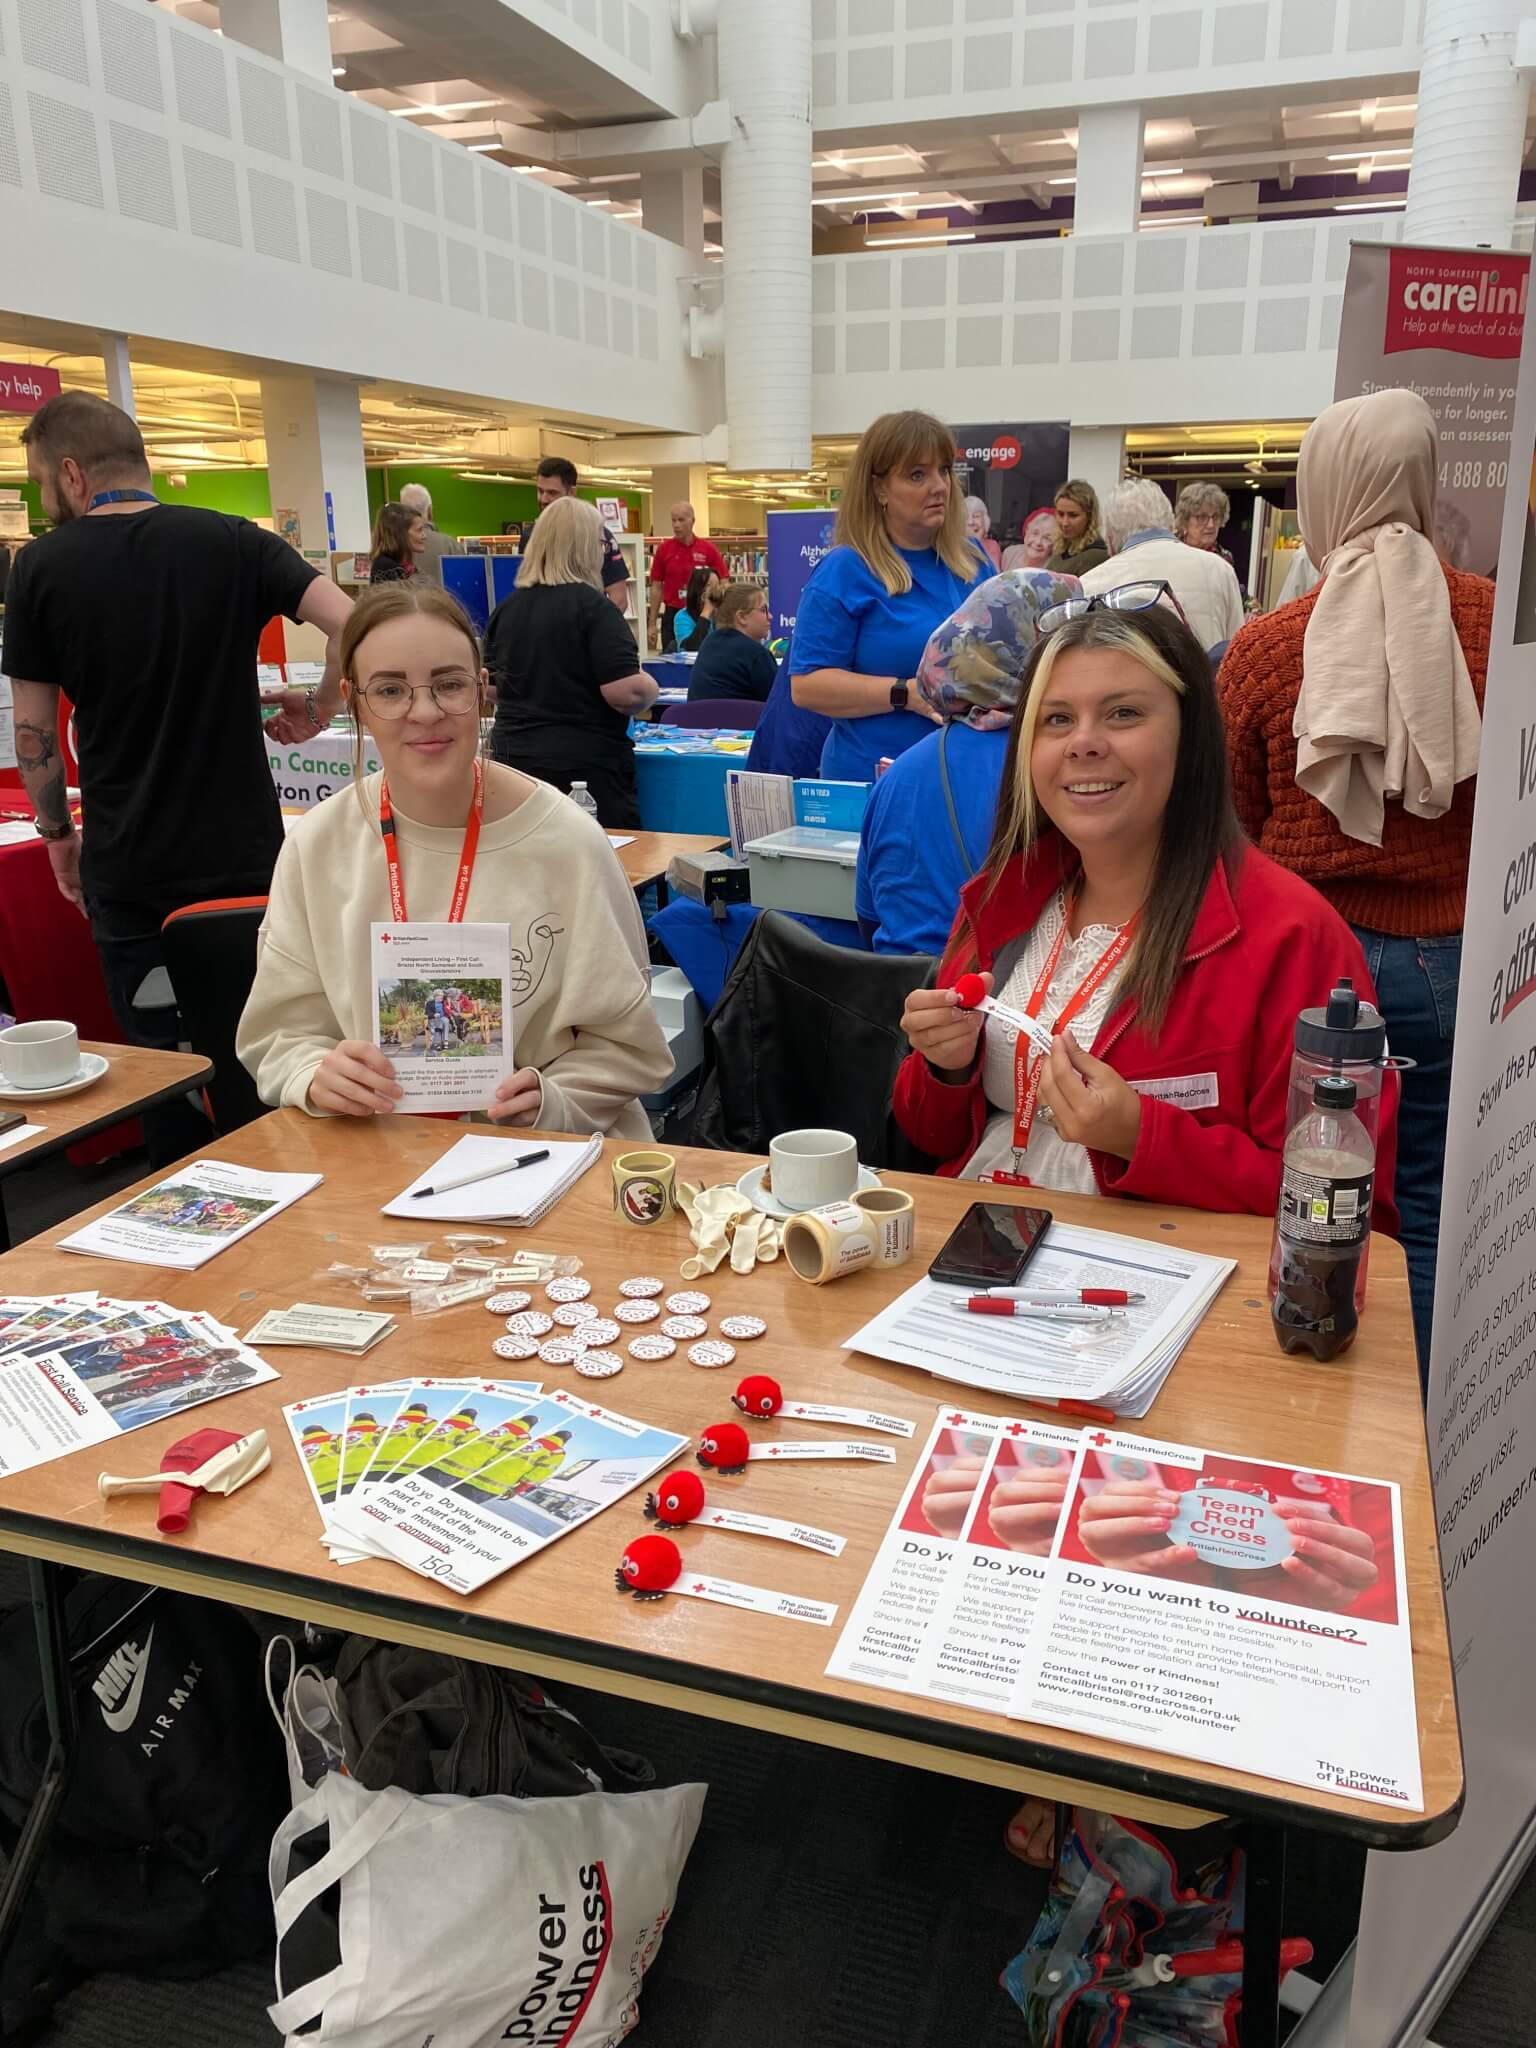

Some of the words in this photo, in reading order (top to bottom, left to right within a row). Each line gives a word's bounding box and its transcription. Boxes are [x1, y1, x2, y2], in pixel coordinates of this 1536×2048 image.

[1406, 266, 1435, 277] NORTH
[1438, 268, 1480, 280] SOMERSET
[1403, 317, 1427, 337] Help
[1429, 320, 1440, 333] at
[1441, 320, 1457, 334] the
[1458, 320, 1484, 336] touch
[1486, 320, 1498, 337] of
[1498, 325, 1506, 337] a
[13, 376, 43, 400] help
[1483, 384, 1494, 398] in
[1440, 430, 1456, 441] an
[1444, 405, 1462, 420] for
[1465, 405, 1508, 425] longer.
[1453, 460, 1482, 488] 888
[1486, 460, 1507, 488] 80
[1080, 935, 1129, 997] redcross.org.uk
[1490, 968, 1504, 1025] a
[1476, 1073, 1504, 1128] Show
[1505, 1054, 1525, 1090] the
[1484, 1145, 1505, 1194] you
[1493, 1189, 1504, 1218] in
[1507, 1160, 1535, 1206] their
[1488, 1225, 1508, 1274] get
[1461, 1330, 1479, 1369] are
[1482, 1318, 1490, 1341] a
[1493, 1277, 1525, 1329] short
[1480, 1346, 1494, 1385] of
[38, 1358, 55, 1376] First
[53, 1372, 69, 1392] Call
[62, 1384, 88, 1416] Service
[1116, 1440, 1197, 1462] BritishRedCross
[389, 1489, 415, 1504] part
[404, 1480, 421, 1492] Do
[1439, 1464, 1488, 1536] register
[1489, 1426, 1519, 1477] visit:
[423, 1506, 446, 1521] part
[446, 1516, 461, 1530] of
[459, 1521, 477, 1536] the
[438, 1497, 455, 1510] Do
[453, 1506, 474, 1522] you
[474, 1516, 502, 1534] want
[500, 1530, 512, 1540] to
[512, 1535, 528, 1548] be
[1197, 1495, 1265, 1518] Team
[1204, 1510, 1256, 1530] Red
[397, 1519, 455, 1555] community
[411, 1512, 468, 1546] movement
[465, 1540, 476, 1551] in
[474, 1548, 502, 1563] your
[903, 1541, 931, 1556] Do
[1187, 1541, 1266, 1562] BritishRedCross
[1190, 1520, 1267, 1545] Cross
[419, 1554, 453, 1577] 150
[972, 1556, 1002, 1570] Do
[1006, 1564, 1046, 1579] you
[797, 1604, 824, 1613] power
[1059, 1599, 1076, 1608] live
[1078, 1602, 1151, 1625] independently
[1154, 1617, 1168, 1626] for
[1171, 1622, 1184, 1630] as
[1186, 1624, 1210, 1637] long
[1229, 1633, 1278, 1650] possible.
[1060, 1590, 1083, 1601] First
[1086, 1595, 1105, 1605] Call
[1107, 1600, 1163, 1617] empowers
[1165, 1611, 1202, 1625] people
[1205, 1618, 1214, 1627] in
[1217, 1621, 1235, 1631] the
[1238, 1625, 1298, 1646] community
[1301, 1639, 1313, 1648] to
[1066, 1571, 1096, 1587] Do
[1101, 1581, 1142, 1597] you
[1147, 1589, 1202, 1609] want
[1208, 1600, 1230, 1614] to
[1236, 1607, 1358, 1641] volunteer?
[866, 1626, 912, 1642] Contact
[943, 1643, 990, 1659] Contact
[992, 1654, 1006, 1662] us
[1059, 1612, 1077, 1623] We
[1079, 1617, 1120, 1633] support
[1122, 1626, 1160, 1640] people
[1162, 1634, 1174, 1643] to
[1176, 1637, 1208, 1651] return
[1211, 1645, 1243, 1658] home
[1246, 1652, 1272, 1664] from
[1275, 1658, 1322, 1677] hospital,
[1325, 1671, 1371, 1687] support
[92, 1640, 145, 1711] NIKE
[1046, 1645, 1079, 1657] Show
[1081, 1652, 1098, 1661] the
[1100, 1656, 1140, 1671] Power
[1143, 1664, 1156, 1674] of
[1159, 1668, 1220, 1689] Kindness!
[1050, 1631, 1087, 1645] reduce
[1090, 1638, 1131, 1654] feelings
[1134, 1646, 1145, 1655] of
[1147, 1650, 1192, 1666] isolation
[1195, 1660, 1217, 1671] and
[1219, 1666, 1278, 1687] loneliness.
[1053, 1622, 1089, 1637] people
[1091, 1629, 1101, 1638] in
[1104, 1632, 1126, 1643] their
[1129, 1638, 1170, 1652] homes,
[1173, 1647, 1195, 1657] and
[1197, 1651, 1239, 1667] provide
[1242, 1661, 1298, 1680] telephone
[1300, 1674, 1345, 1691] support
[1349, 1685, 1361, 1694] to
[1040, 1671, 1241, 1723] firstcallbristol@redscross.org.uk
[1042, 1661, 1090, 1678] Contact
[1094, 1673, 1108, 1682] us
[1111, 1677, 1127, 1686] on
[1130, 1680, 1159, 1693] 0117
[1162, 1688, 1213, 1705] 3012601
[141, 1713, 175, 1758] AIR
[168, 1659, 204, 1711] MAX
[1037, 1683, 1236, 1732] www.redcross.org.uk/volunteer
[1316, 1760, 1344, 1774] The
[1349, 1770, 1398, 1786] power
[1316, 1772, 1332, 1781] of
[1335, 1774, 1409, 1801] kindness
[501, 1893, 567, 2041] power
[528, 1863, 607, 2048] indness
